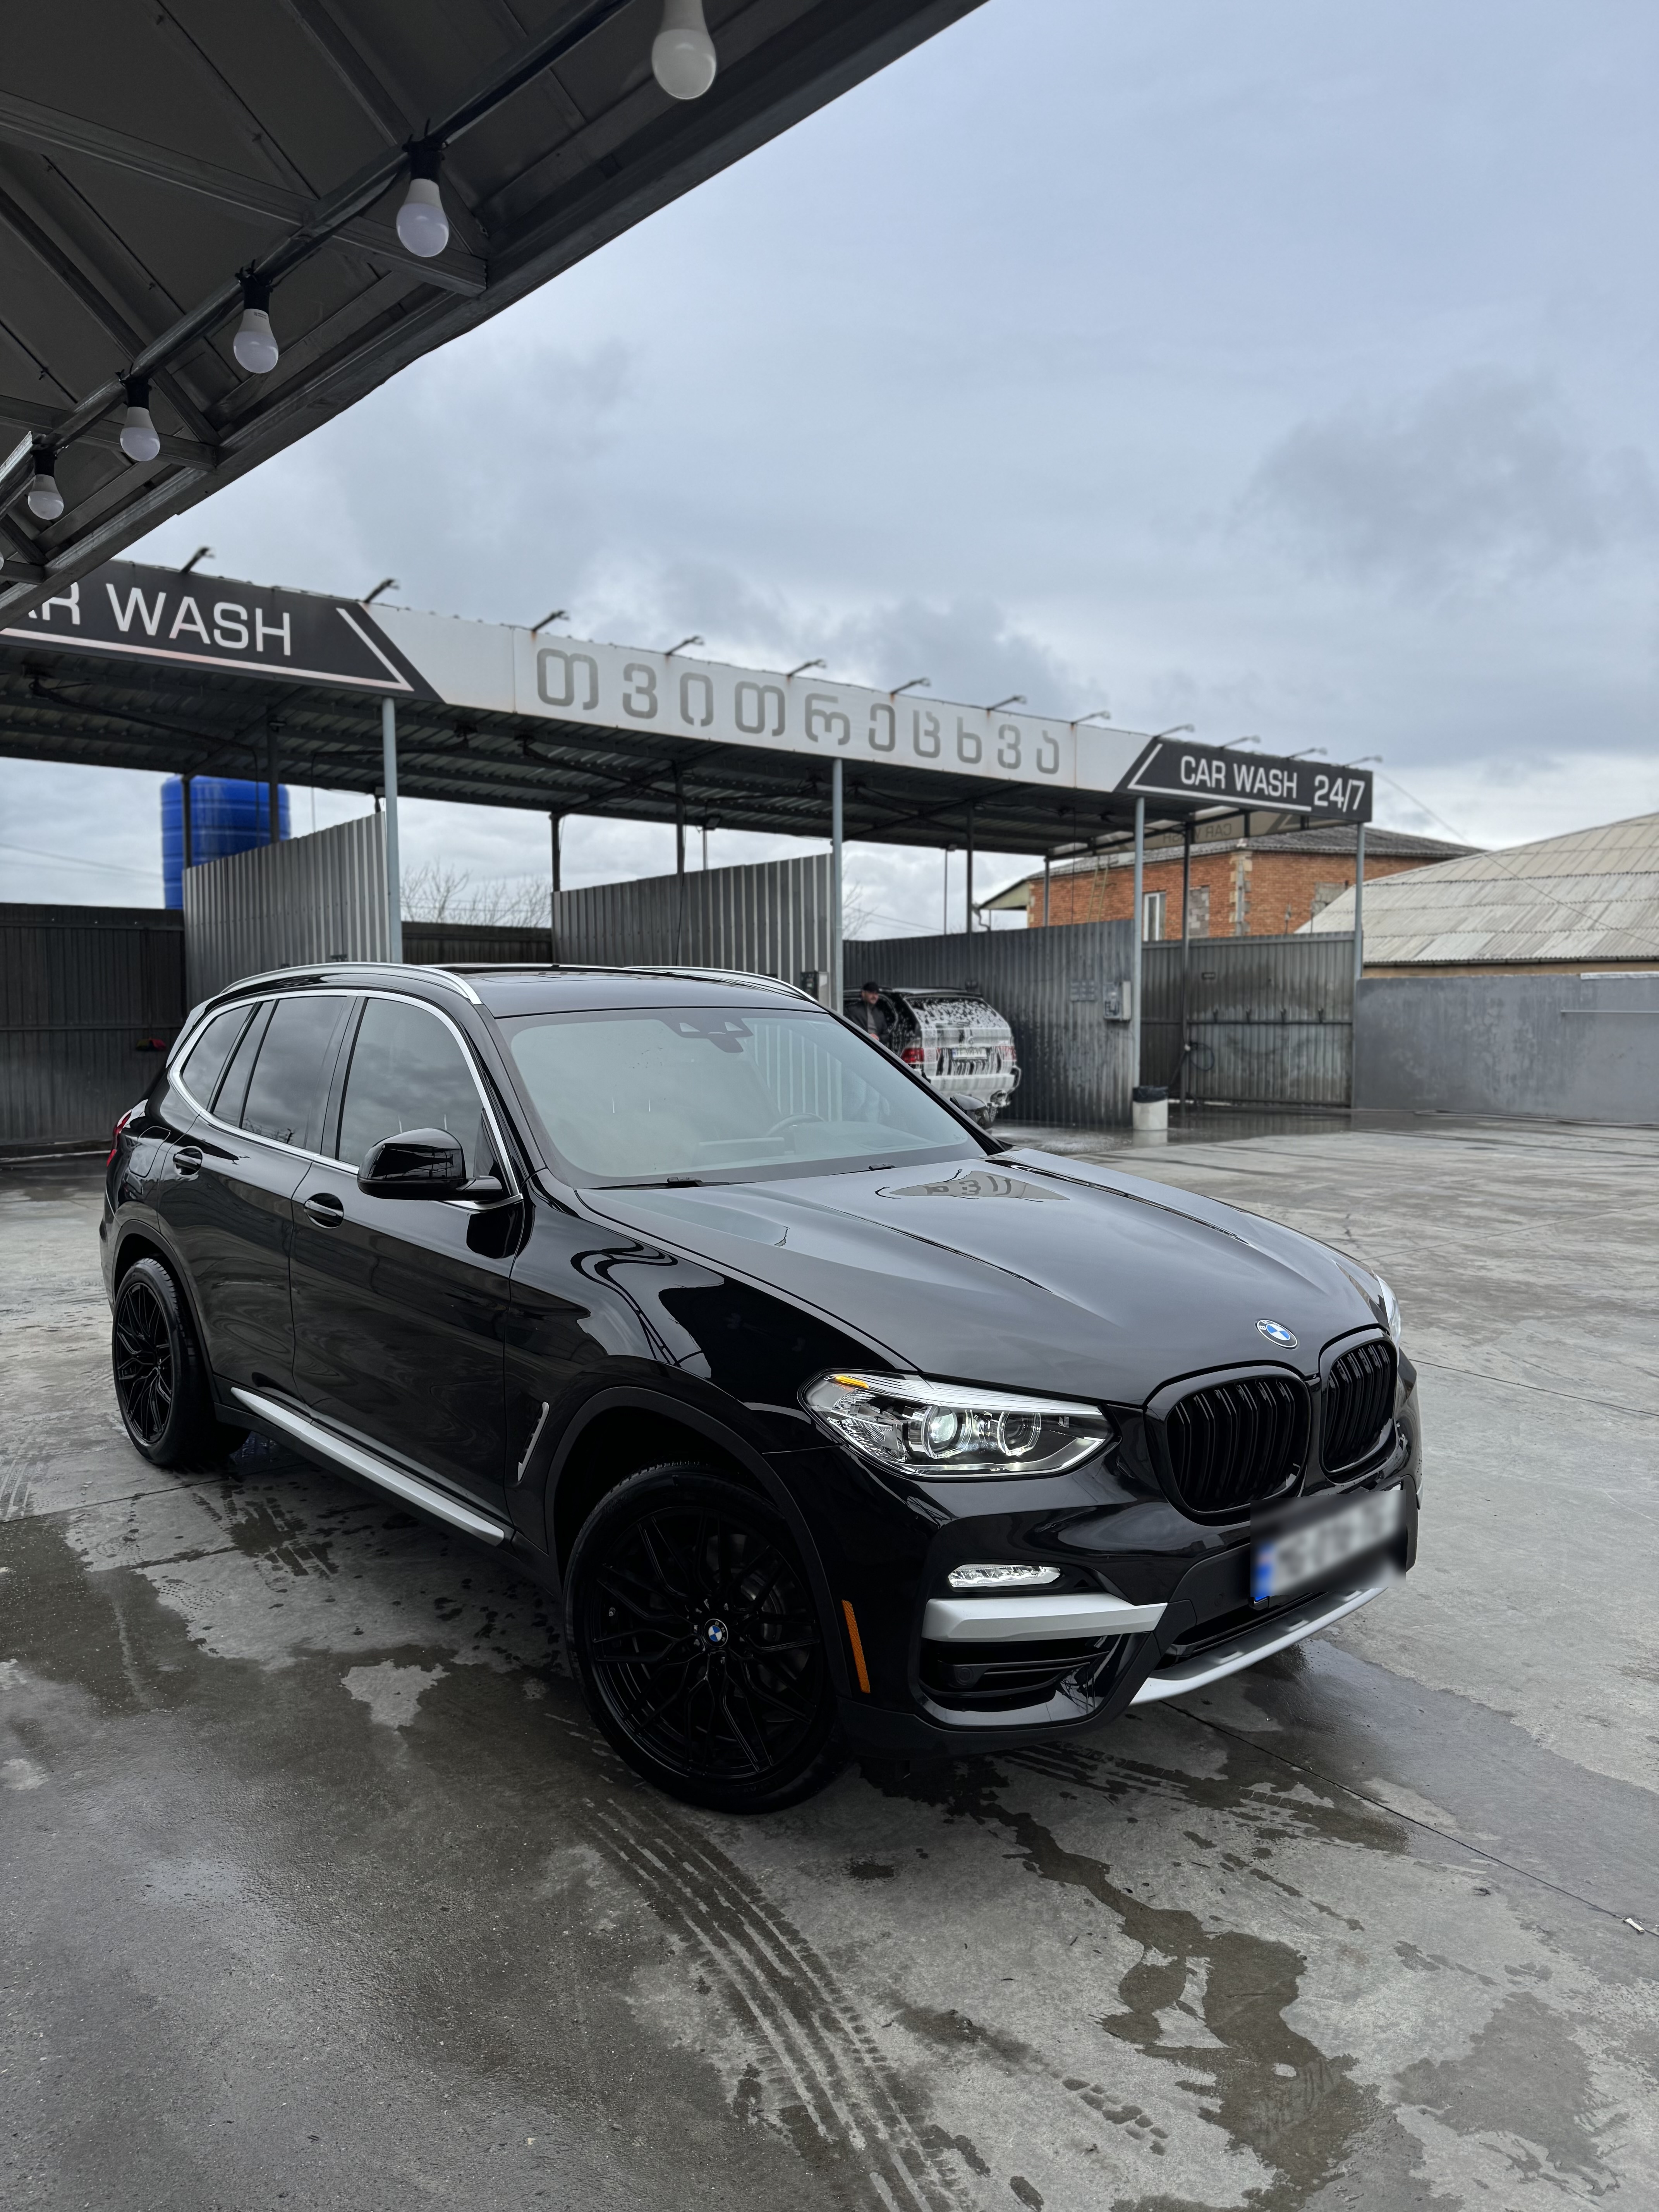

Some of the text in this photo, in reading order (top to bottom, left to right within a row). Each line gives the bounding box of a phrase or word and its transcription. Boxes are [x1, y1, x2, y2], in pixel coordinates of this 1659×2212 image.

[106, 584, 290, 655] WASH
[537, 648, 1060, 775] თვითრეცხვა
[1181, 756, 1365, 812] CAR WASH 24/7
